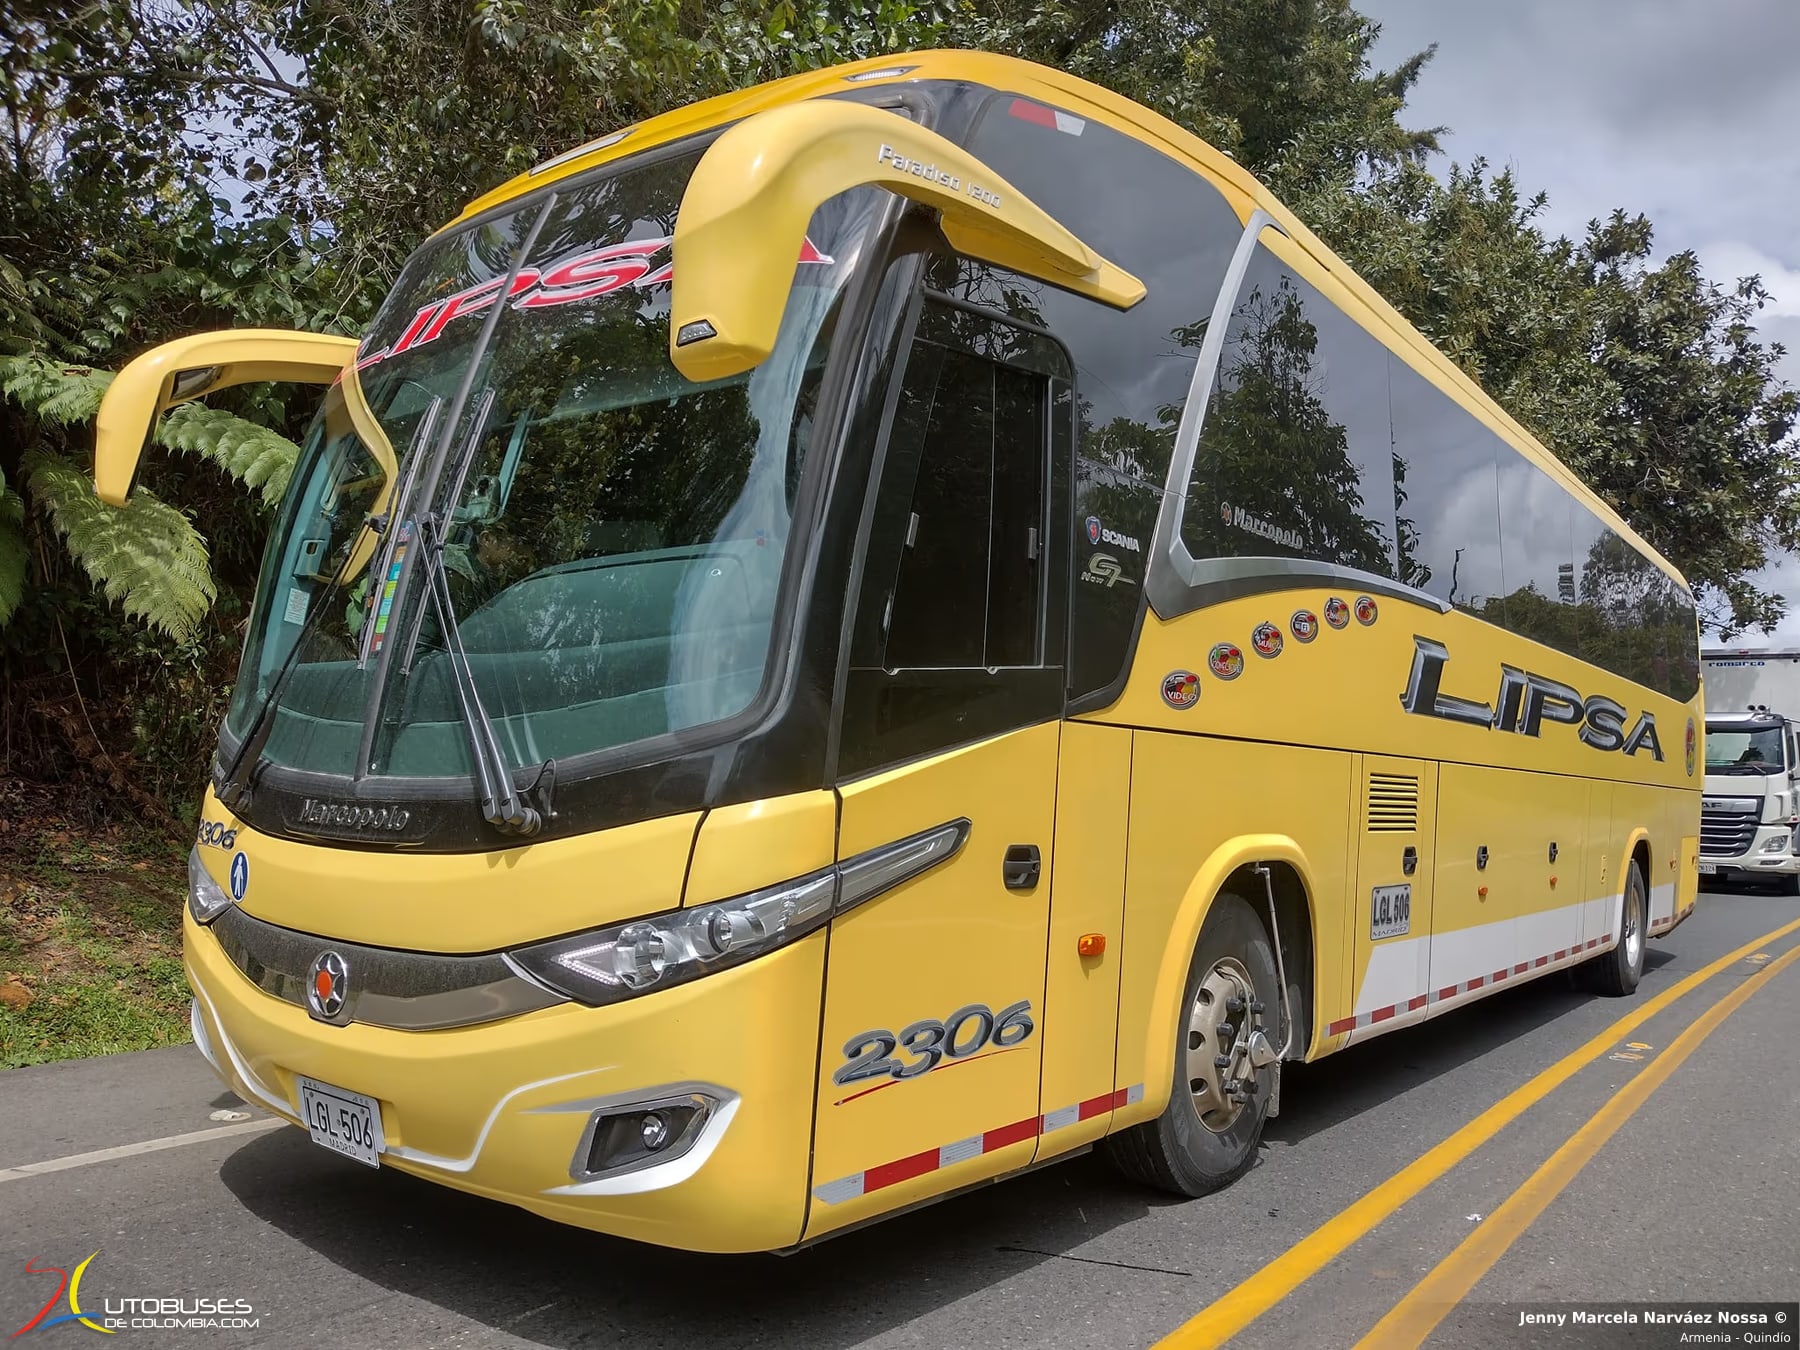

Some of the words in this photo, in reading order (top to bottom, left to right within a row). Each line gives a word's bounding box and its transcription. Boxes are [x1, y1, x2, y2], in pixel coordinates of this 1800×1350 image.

[878, 143, 961, 191] Paradiso
[966, 181, 1001, 209] 1200
[1101, 528, 1140, 553] SCANIA
[1233, 505, 1304, 550] Marcopolo
[1167, 690, 1197, 701] VIDEO
[1400, 634, 1665, 763] LIPSA
[300, 798, 411, 832] Marcopolo
[832, 1000, 1035, 1086] 2306
[306, 1097, 338, 1137] LGL
[340, 1108, 373, 1149] 506
